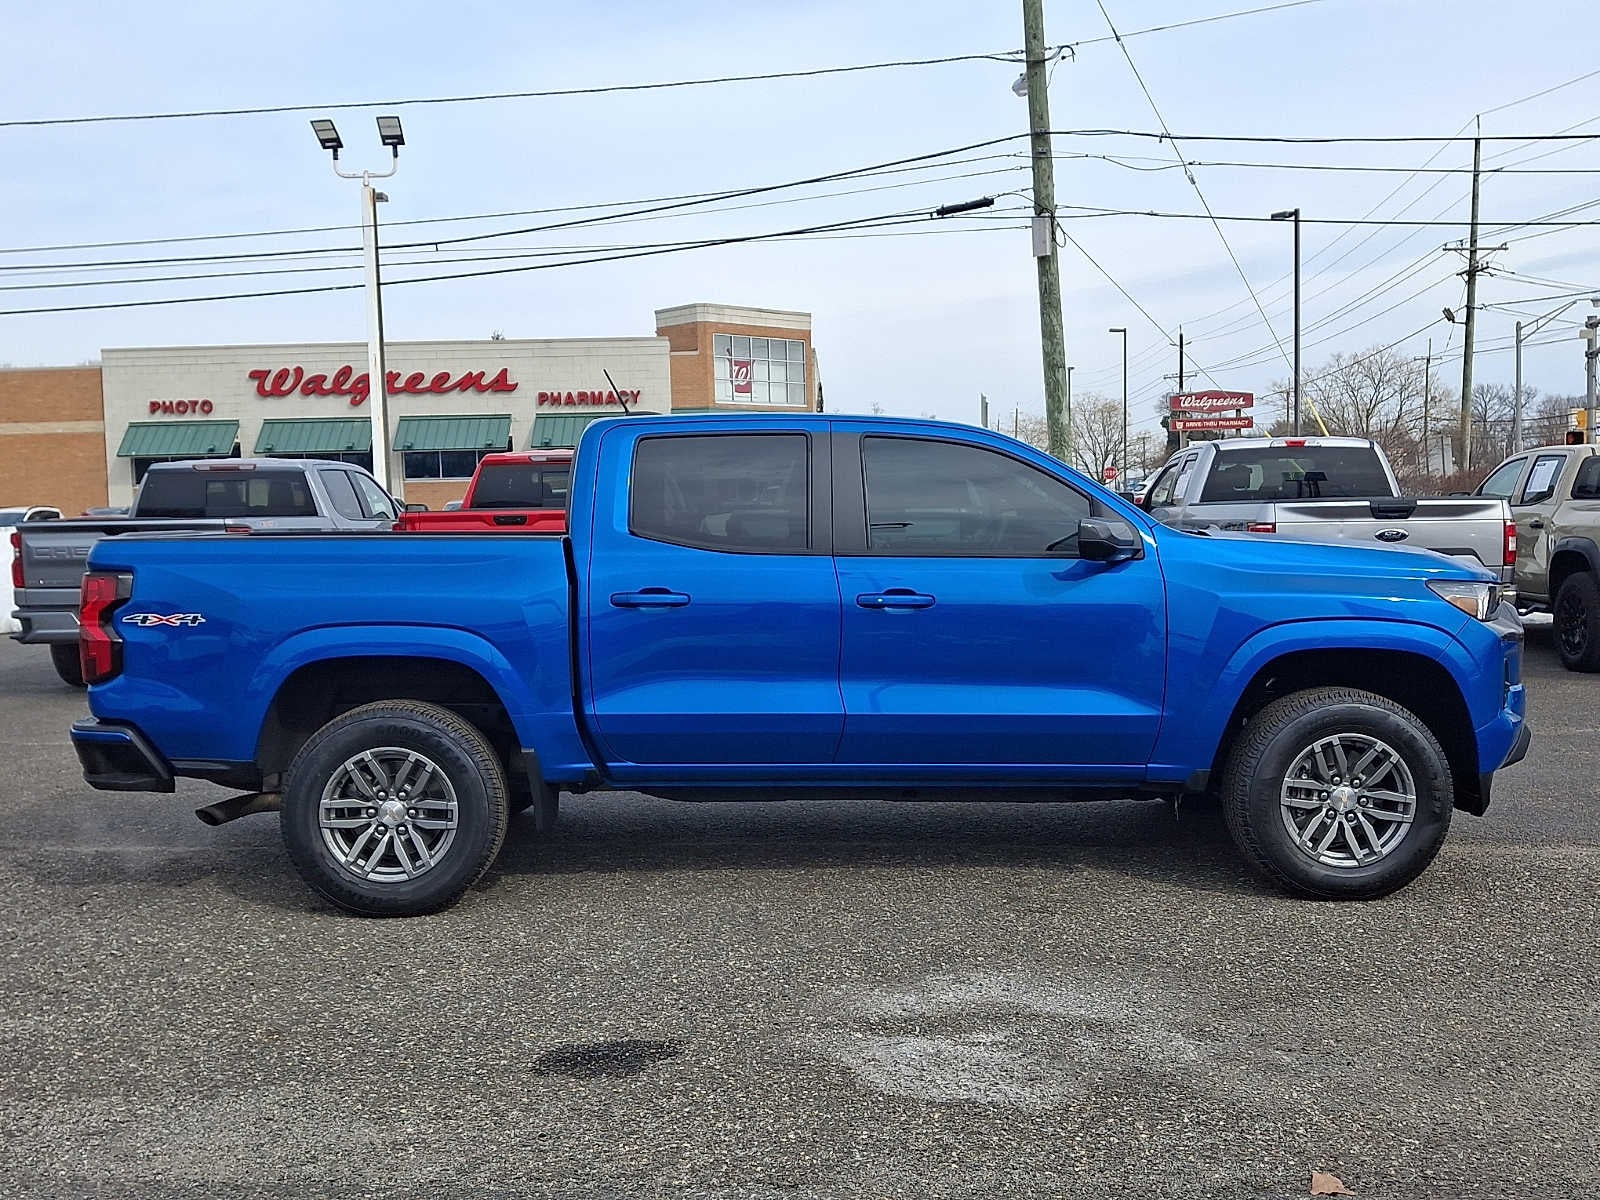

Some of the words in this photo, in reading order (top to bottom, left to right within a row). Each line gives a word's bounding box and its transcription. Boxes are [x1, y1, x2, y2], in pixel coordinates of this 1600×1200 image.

[249, 365, 518, 406] Walgreens
[538, 389, 640, 406] PHARMACY
[1180, 395, 1245, 410] Walgreens
[149, 399, 213, 415] PHOTO
